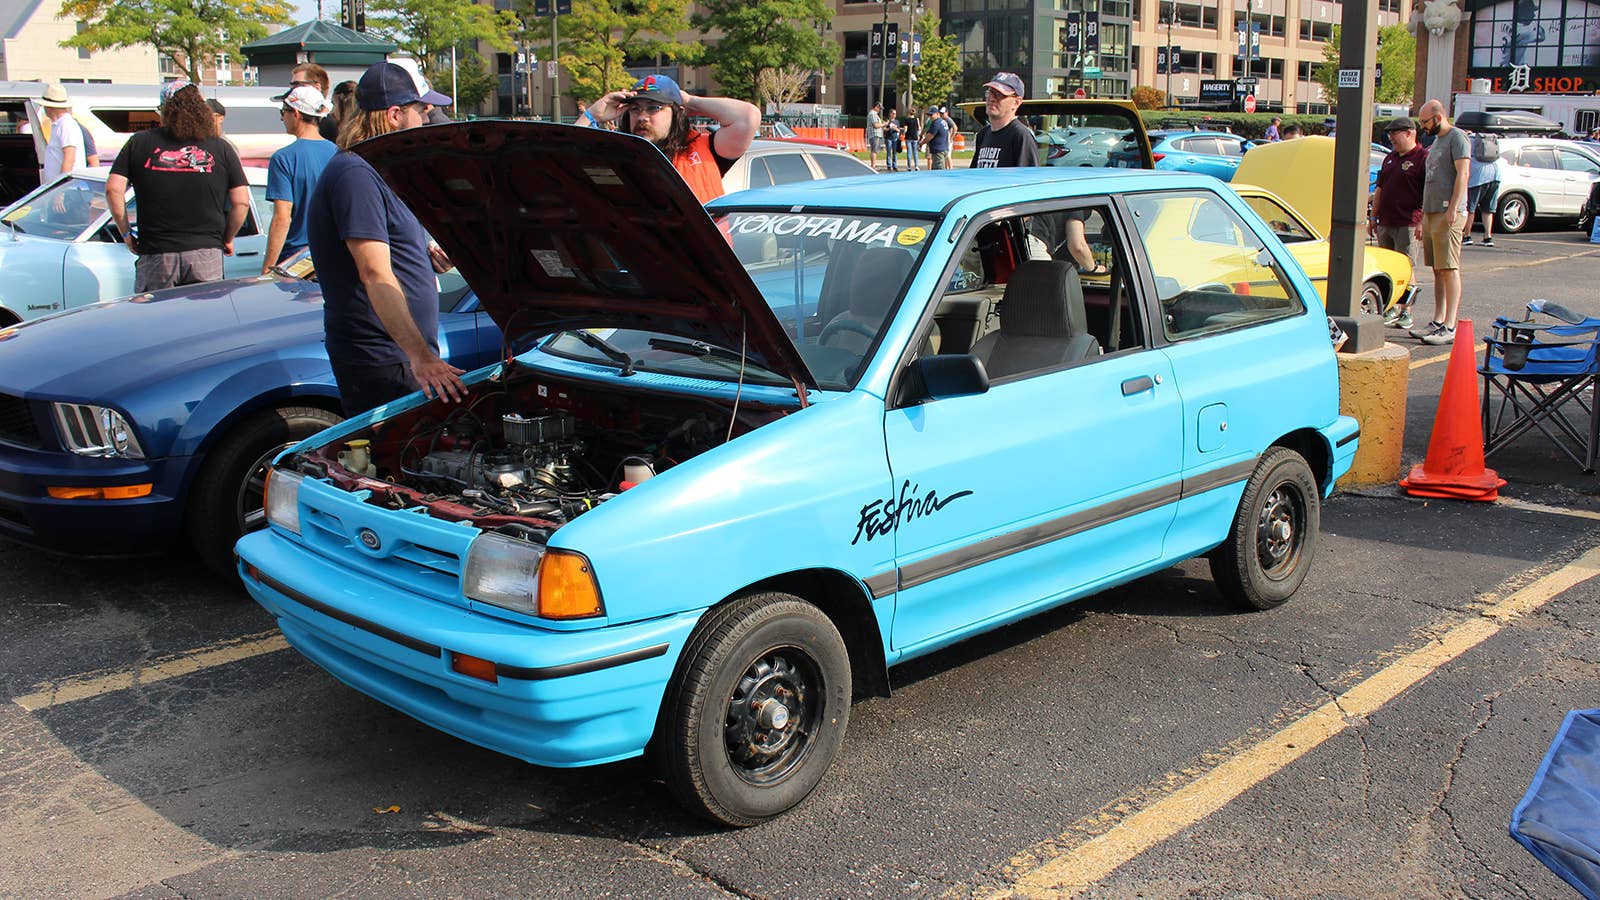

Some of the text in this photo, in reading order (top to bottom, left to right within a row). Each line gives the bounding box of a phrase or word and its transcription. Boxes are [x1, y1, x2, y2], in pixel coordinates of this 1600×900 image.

[1202, 83, 1231, 91] HAGERTY
[1465, 77, 1503, 92] TE
[1533, 77, 1584, 93] SHOP
[727, 215, 898, 247] YOKOHAMA
